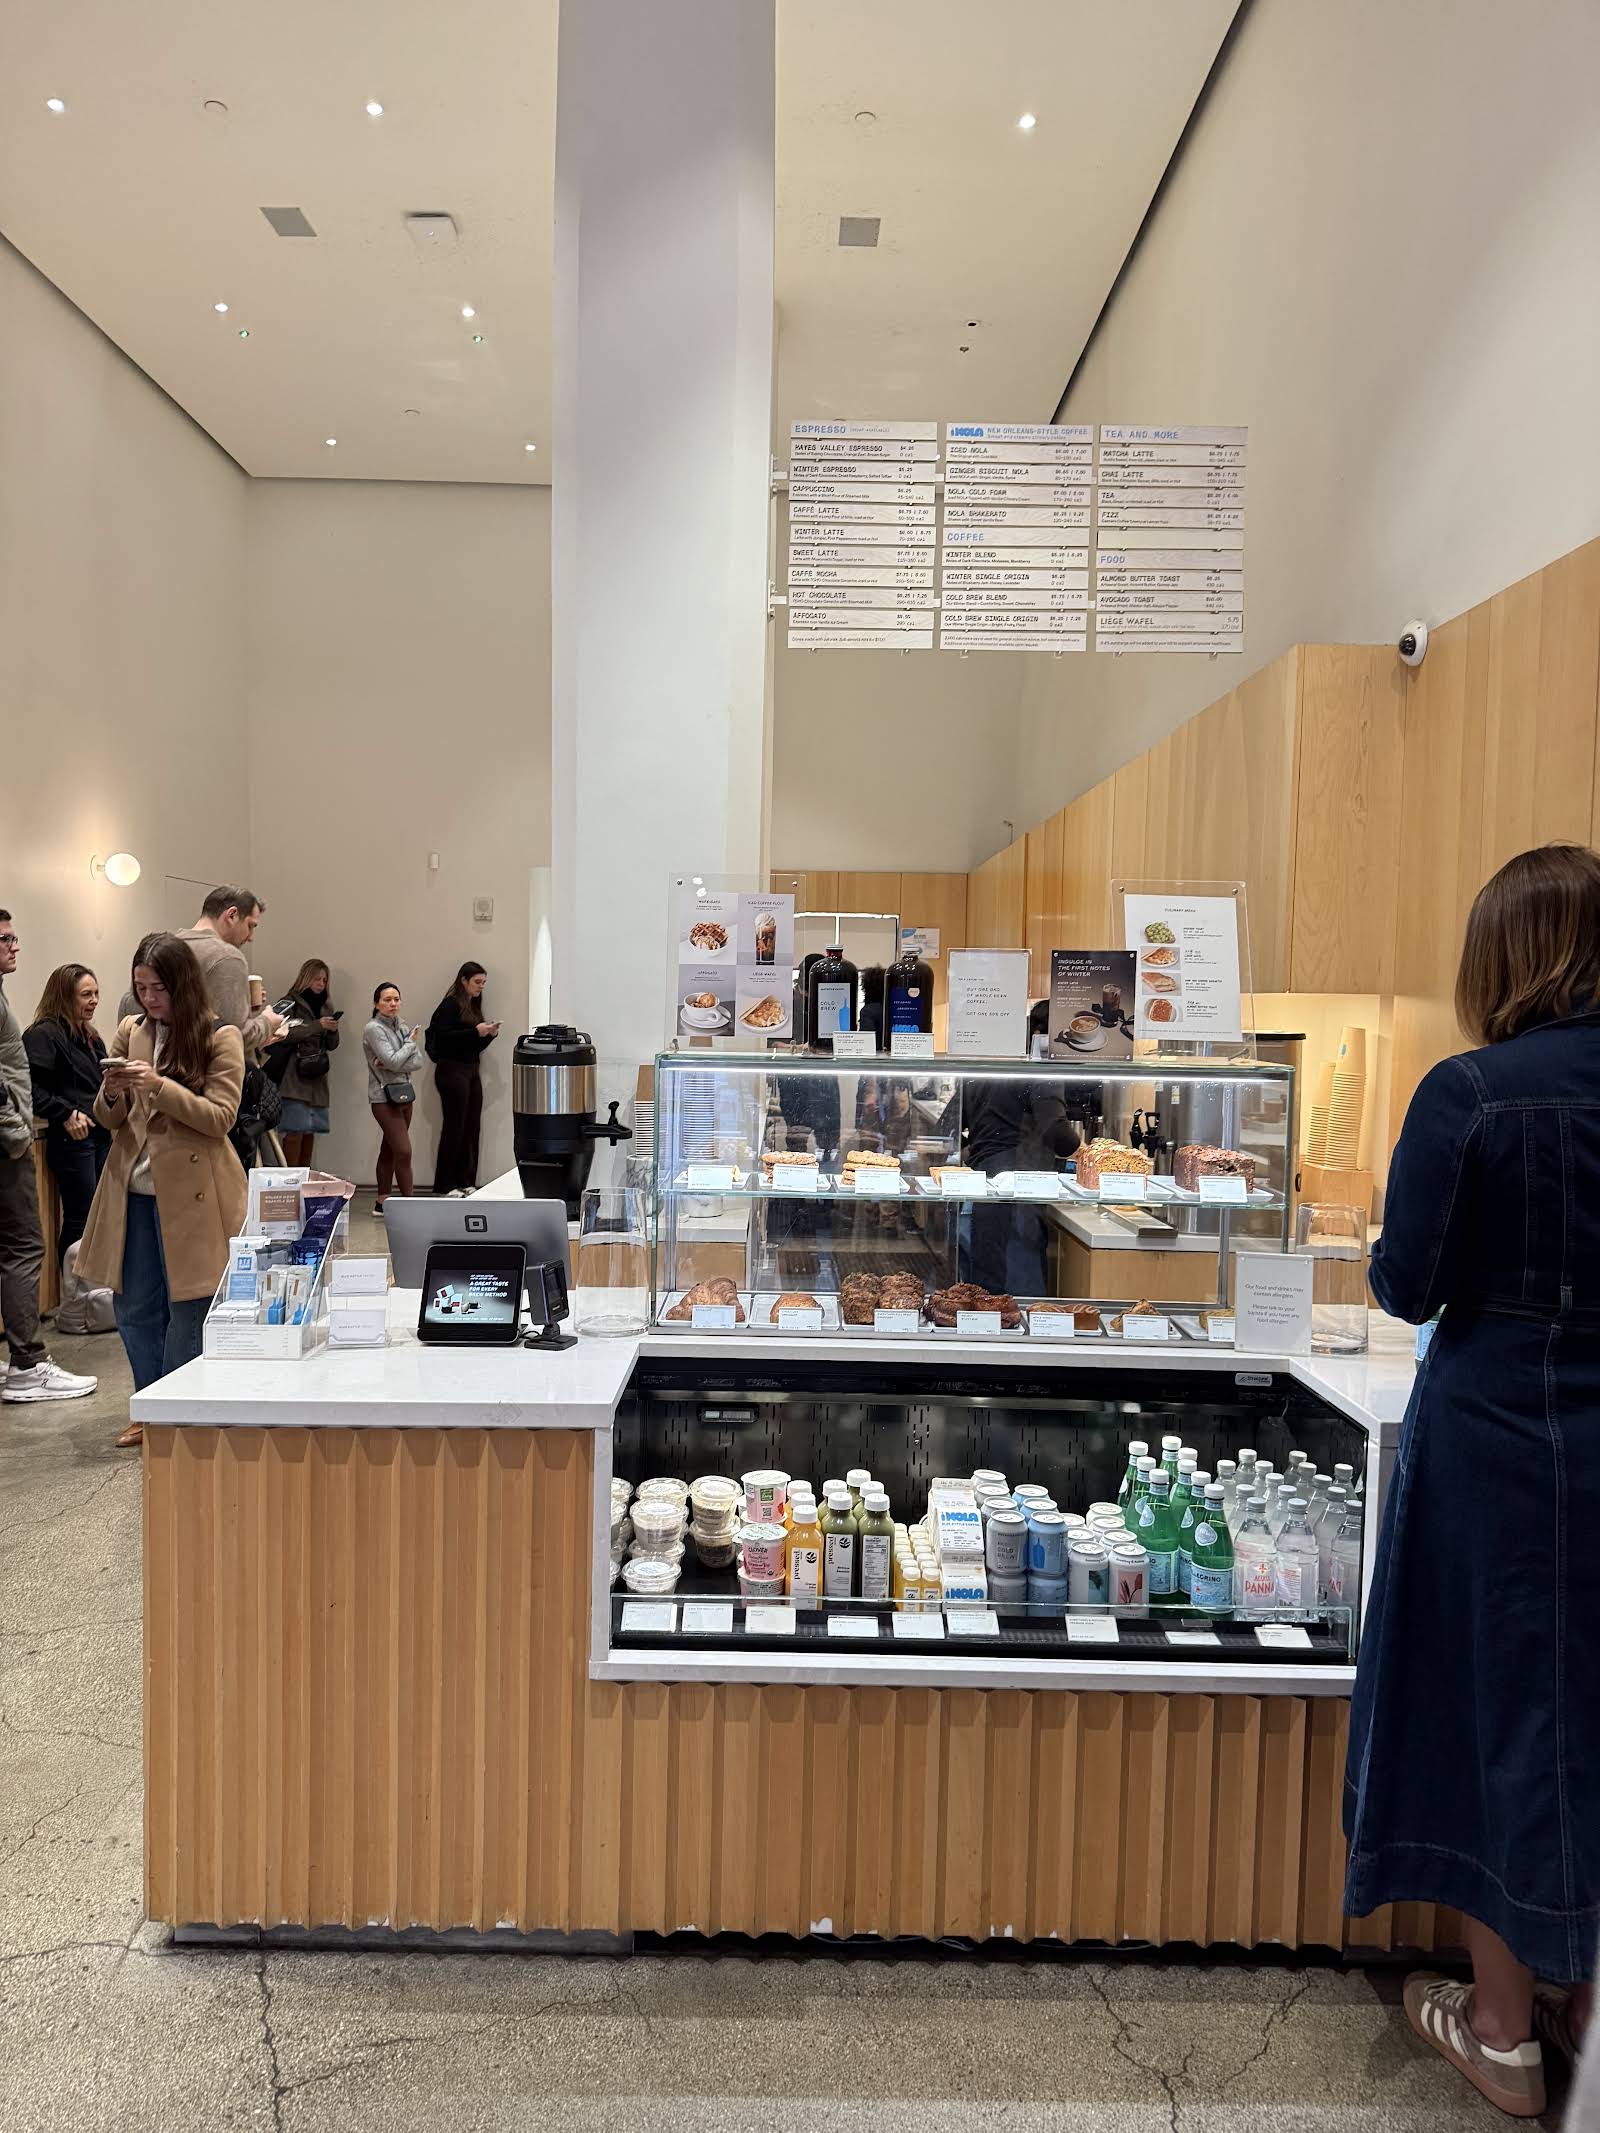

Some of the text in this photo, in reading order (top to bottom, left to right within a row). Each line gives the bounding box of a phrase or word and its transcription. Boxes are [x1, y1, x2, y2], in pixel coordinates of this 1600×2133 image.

[796, 425, 846, 433] ESPRESSO
[1104, 430, 1122, 438] TEA
[948, 533, 984, 541] COFFEE
[946, 1512, 978, 1522] NOLA
